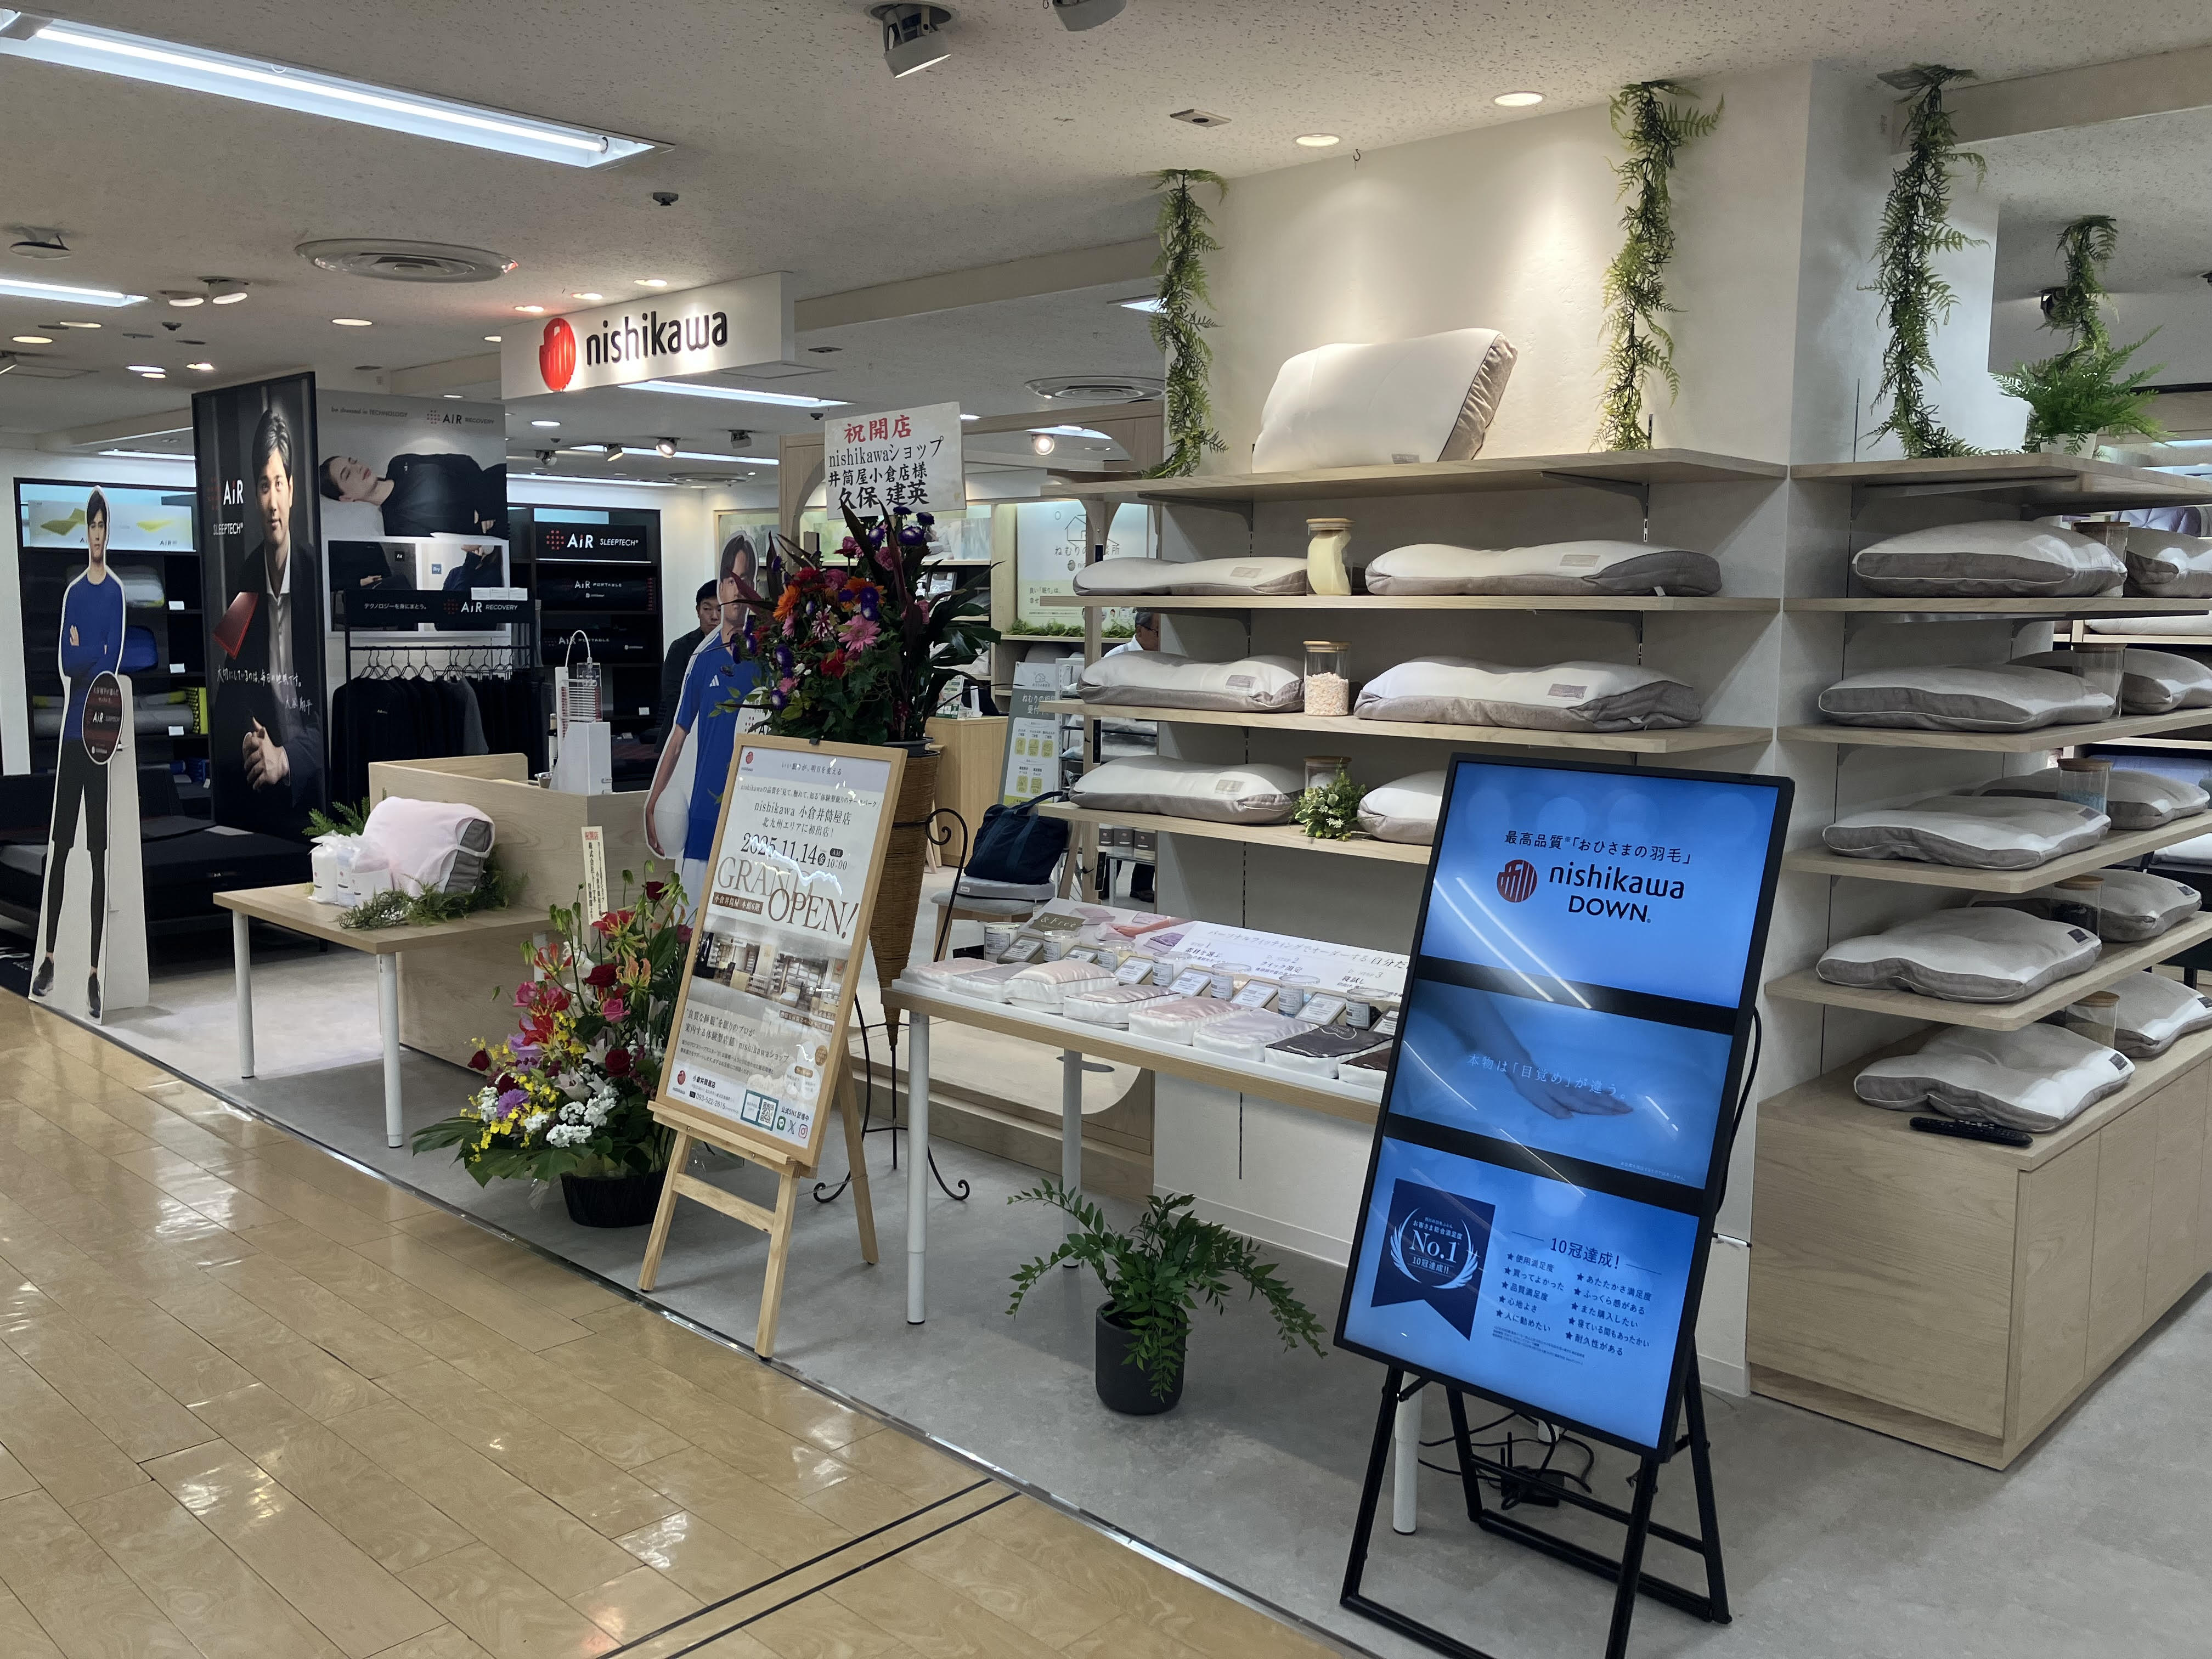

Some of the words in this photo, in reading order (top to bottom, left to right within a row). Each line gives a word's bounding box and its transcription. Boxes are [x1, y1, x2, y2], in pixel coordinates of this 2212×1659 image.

[586, 311, 728, 366] nishikawa
[844, 414, 912, 444] 祝開店
[829, 435, 944, 467] nishikawaショップ
[828, 461, 928, 488] 井筒屋小倉店様
[1054, 544, 1120, 556] ねむりの所
[754, 800, 795, 817] nishikawa
[799, 805, 852, 825] 小倉井筒屋店
[741, 832, 818, 865] 202511.14
[827, 858, 848, 871] 10:00
[717, 856, 814, 903] GRAND
[1549, 861, 1685, 899] nishikawa
[768, 888, 860, 939] OPEN!
[1468, 1054, 1626, 1098] 本物は「目覚め」が違う。
[696, 1093, 726, 1110] 093-522-2615
[1408, 1229, 1457, 1263] No.1
[1516, 1254, 1554, 1273] 使用満足度
[1510, 1282, 1549, 1302] 品質満足度
[1513, 1268, 1565, 1291] 買ってよかった
[1586, 1275, 1652, 1302] あたたかさ満足度
[1507, 1297, 1538, 1313] 心地よさ
[1583, 1291, 1645, 1315] ふっくら感がある
[1504, 1312, 1550, 1332] 人に勧めたい
[1581, 1305, 1638, 1328] また購入したい
[1575, 1333, 1623, 1356] 耐久性がある
[1578, 1318, 1650, 1347] 寝ている間もあったかい
